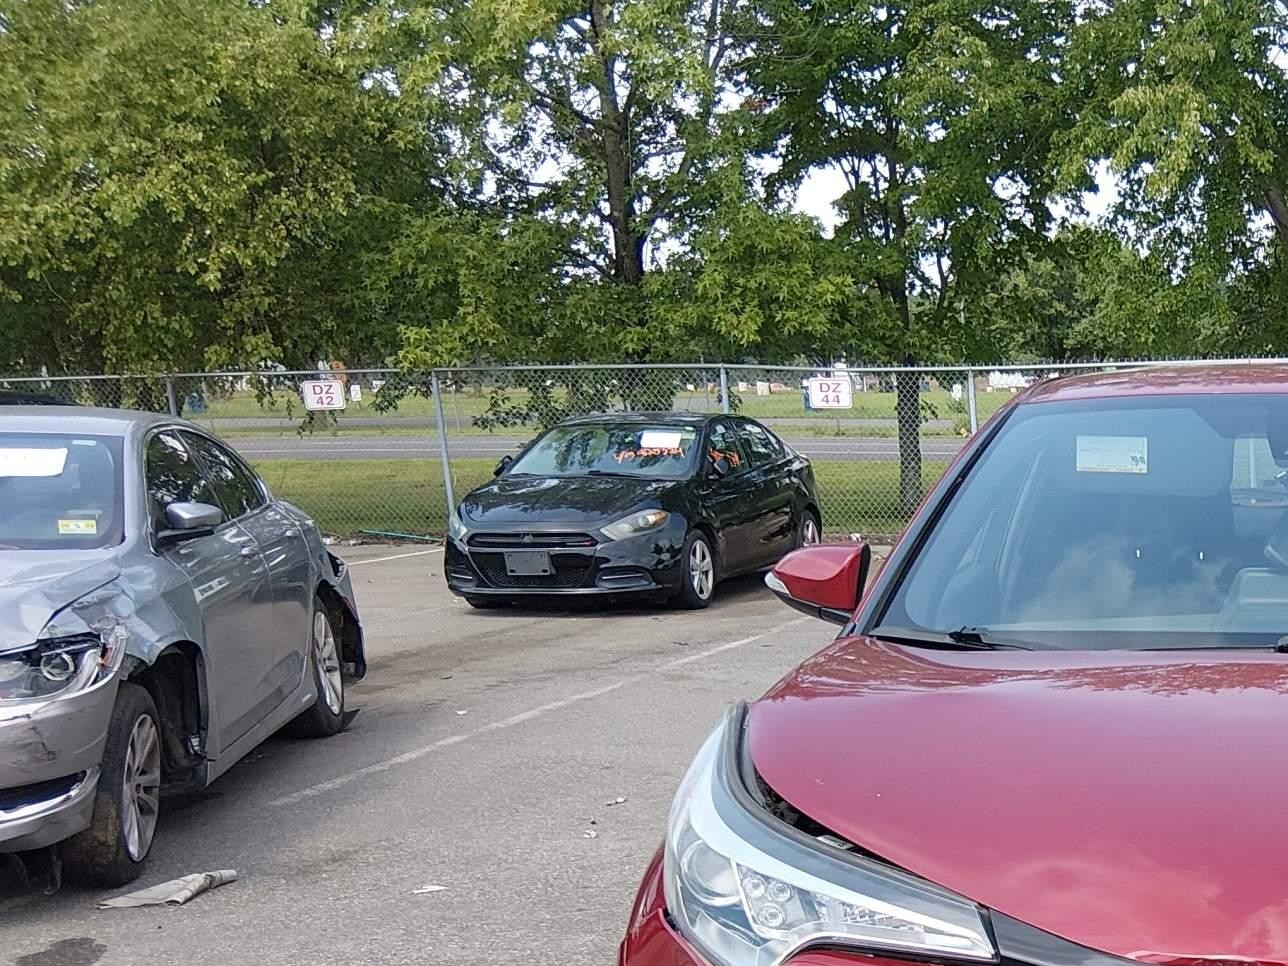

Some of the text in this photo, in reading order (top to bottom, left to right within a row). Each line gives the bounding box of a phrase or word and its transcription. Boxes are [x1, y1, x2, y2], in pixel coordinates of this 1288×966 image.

[312, 384, 335, 395] DZ
[819, 382, 841, 393] DZ
[315, 395, 335, 406] 42
[821, 394, 840, 405] 44
